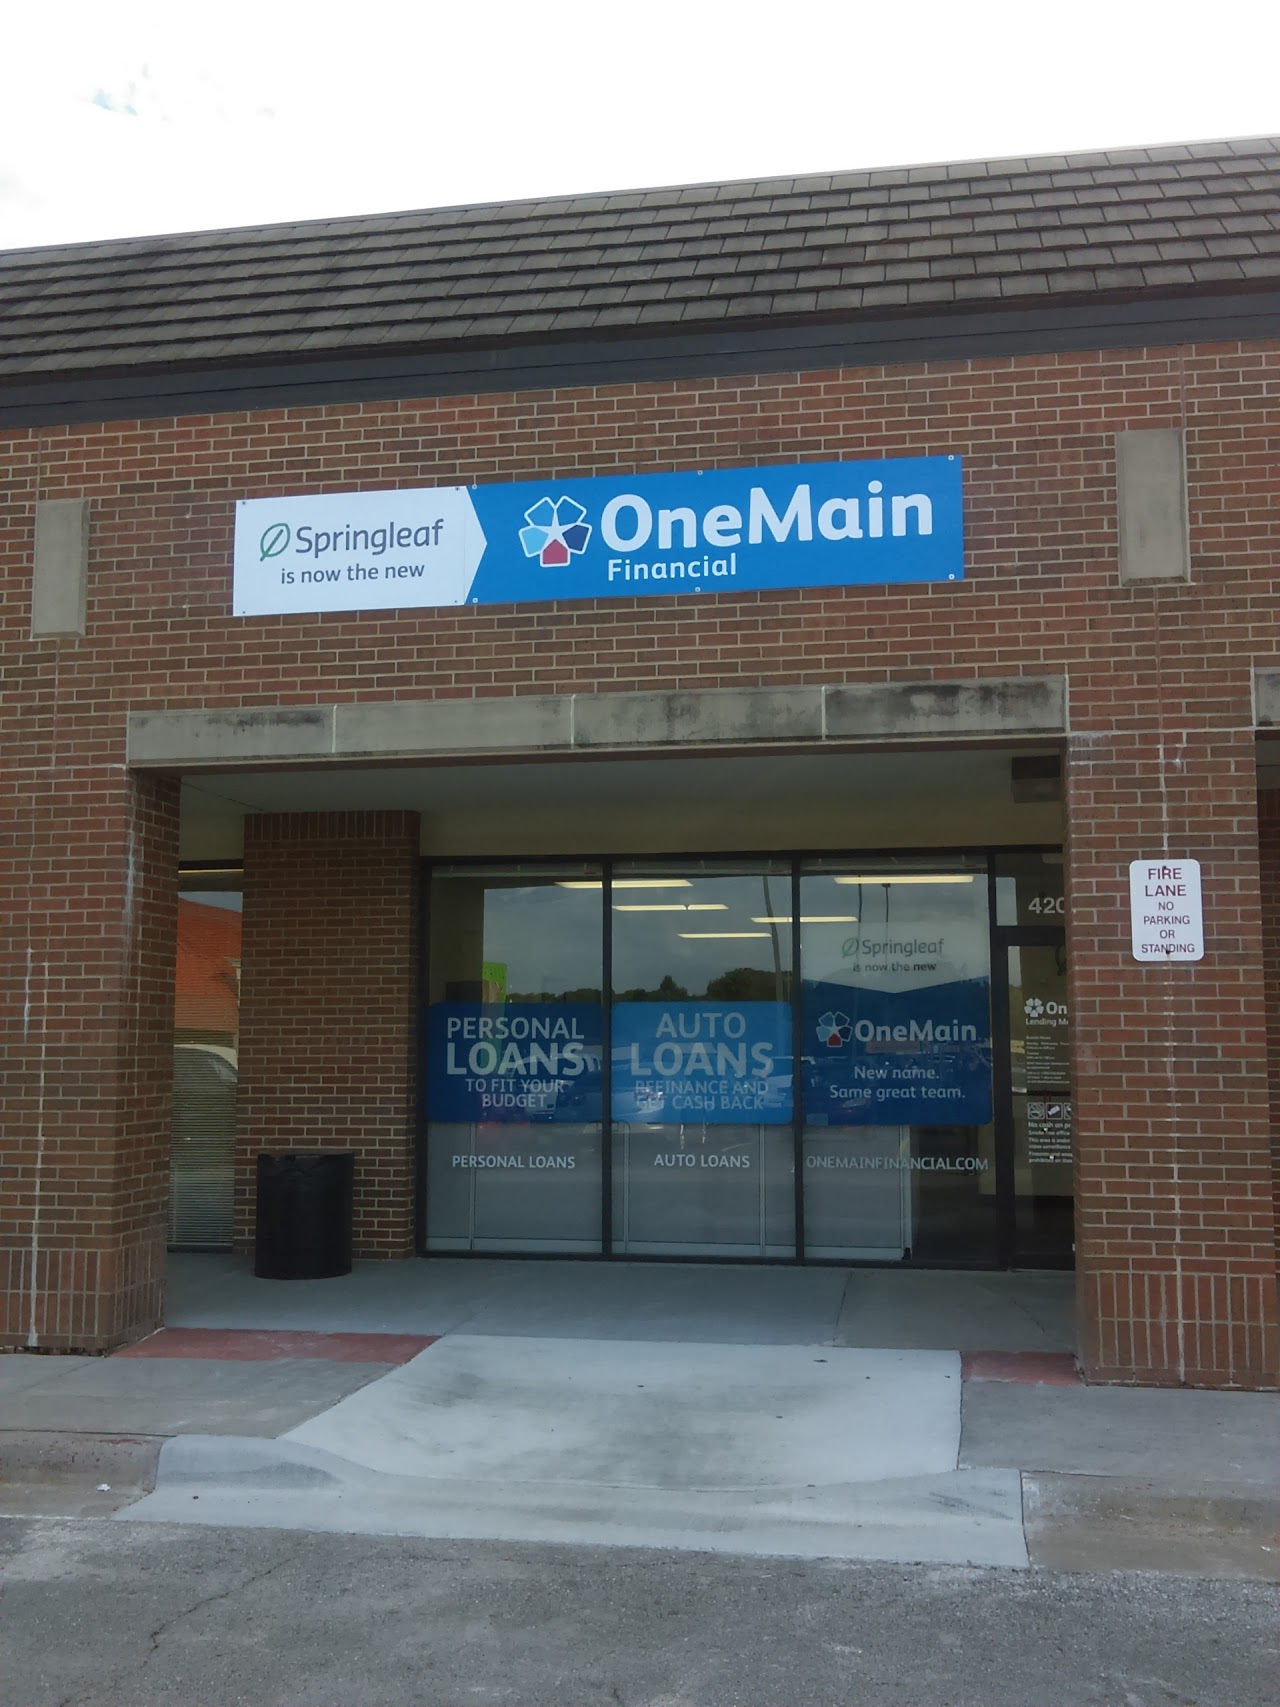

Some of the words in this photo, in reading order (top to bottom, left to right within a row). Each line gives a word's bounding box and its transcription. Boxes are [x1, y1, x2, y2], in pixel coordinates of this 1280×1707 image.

[600, 480, 933, 552] OneMain
[295, 518, 444, 558] Springleaf
[281, 568, 295, 584] is
[301, 569, 341, 583] now
[347, 563, 379, 581] the
[385, 564, 425, 579] new
[608, 553, 737, 581] Financial
[1148, 867, 1182, 880] FIRE
[1144, 884, 1187, 897] LANE
[1158, 901, 1174, 911] NO
[1143, 915, 1190, 925] PARKING
[1159, 929, 1175, 939] OR
[862, 938, 944, 957] Springleaf
[1141, 943, 1195, 953] STANDING
[853, 961, 861, 972] is
[865, 963, 888, 972] now
[891, 961, 910, 972] the
[913, 962, 937, 971] new
[446, 1017, 584, 1039] PERSONAL
[655, 1012, 746, 1039] AUTO
[854, 1019, 977, 1042] OneMain
[446, 1042, 584, 1075] LOANS
[631, 1042, 774, 1077] LOANS
[854, 1066, 888, 1079] New
[892, 1068, 940, 1079] name.
[465, 1079, 486, 1093] TO
[491, 1079, 518, 1093] FIT
[520, 1079, 565, 1093] YOUR
[635, 1080, 728, 1094] REFINANCE
[733, 1080, 769, 1094] AND
[829, 1085, 872, 1099] Same
[876, 1086, 916, 1102] great
[921, 1086, 966, 1098] team.
[481, 1093, 547, 1108] BUDGET
[672, 1095, 715, 1110] CASH
[721, 1095, 765, 1110] BACK
[452, 1155, 525, 1169] PERSONAL
[529, 1155, 576, 1169] LOANS
[653, 1154, 697, 1168] AUTO
[700, 1154, 750, 1169] LOANS
[806, 1155, 989, 1171] ONEMAINFINANCIAL.COM
